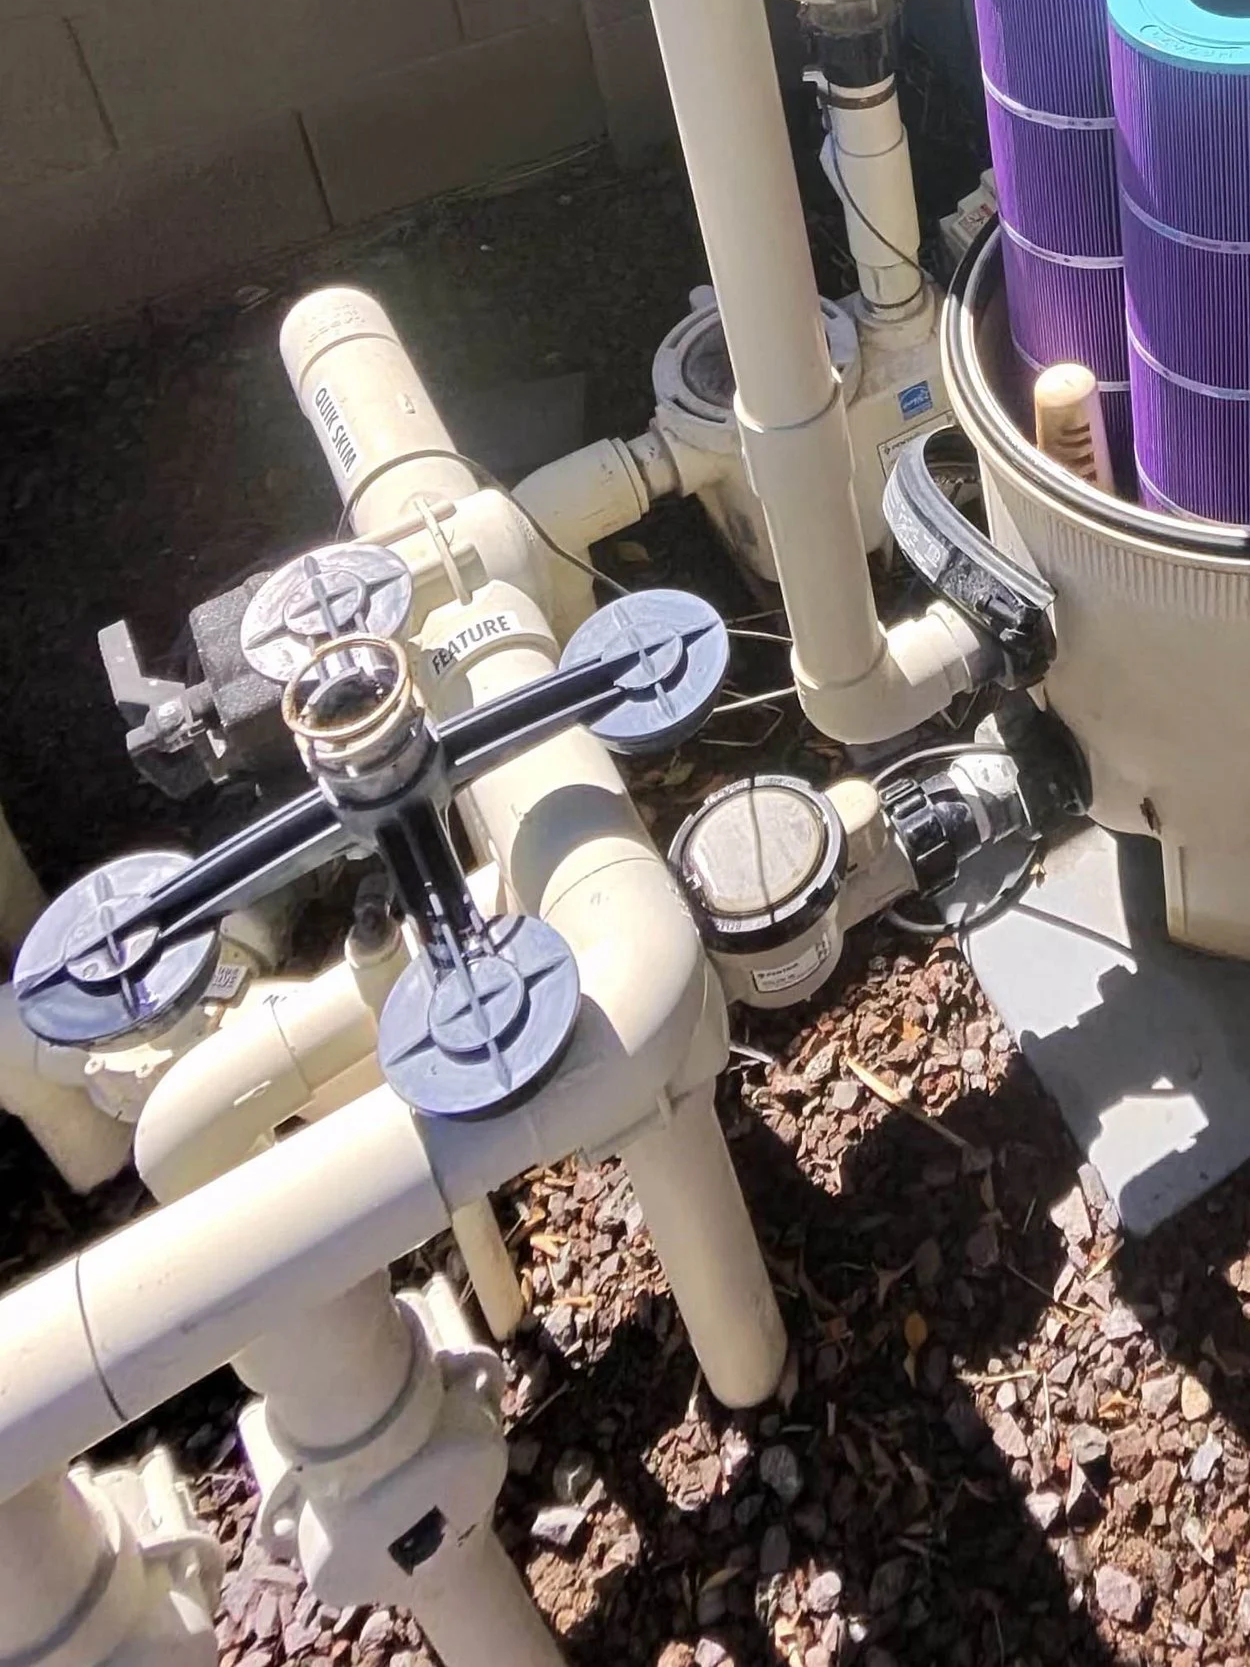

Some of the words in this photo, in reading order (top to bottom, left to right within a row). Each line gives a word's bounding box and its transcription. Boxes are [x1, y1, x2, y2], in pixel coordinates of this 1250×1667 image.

[315, 387, 339, 433] QUIK
[332, 424, 357, 473] SKIM
[431, 615, 511, 675] FEATURE
